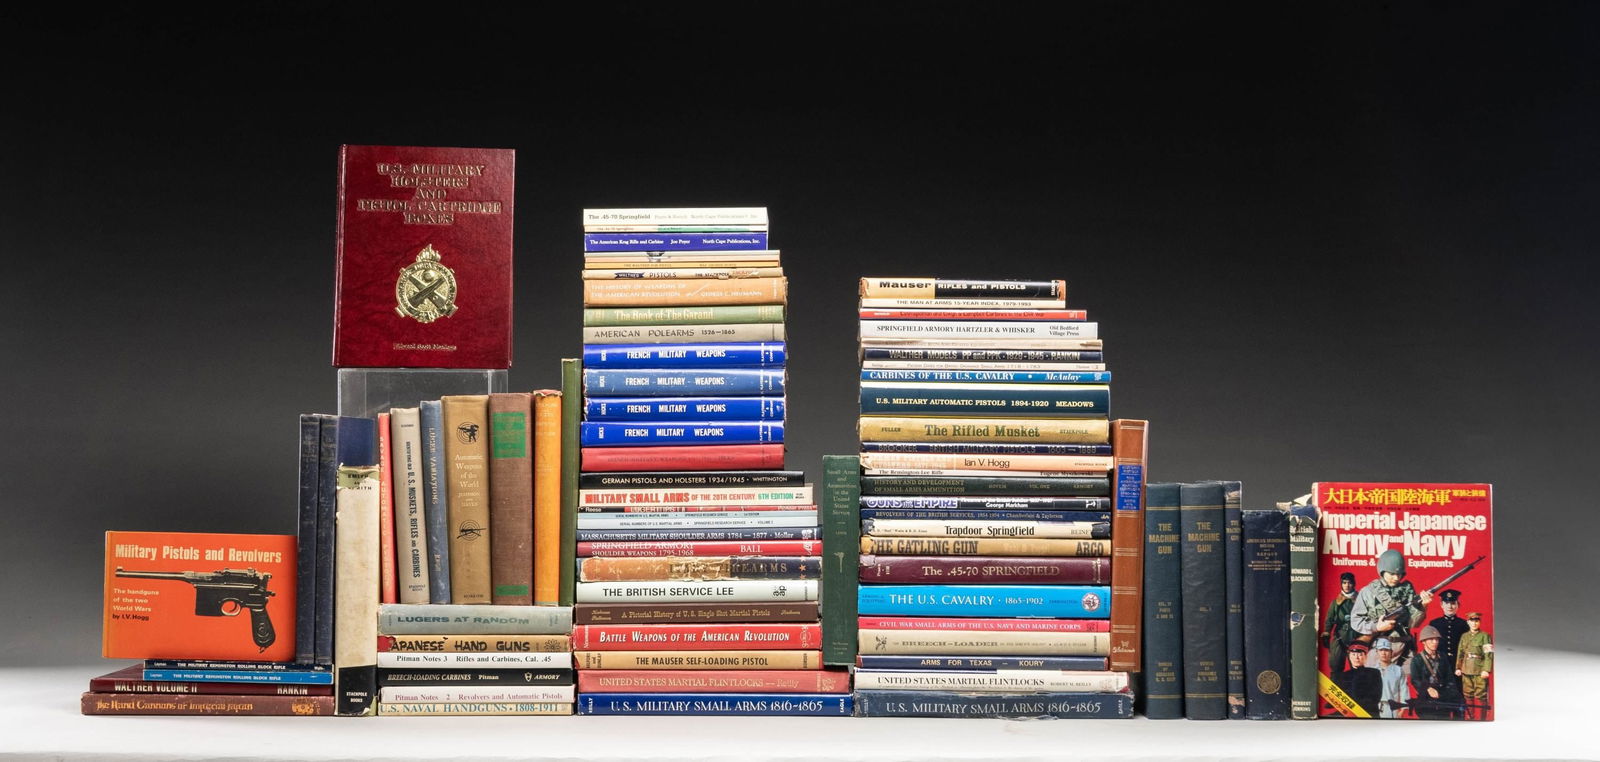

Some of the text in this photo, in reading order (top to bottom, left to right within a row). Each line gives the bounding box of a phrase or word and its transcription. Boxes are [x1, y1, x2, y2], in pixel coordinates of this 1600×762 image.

[411, 164, 484, 176] MILITARY
[415, 187, 447, 199] AND
[418, 201, 501, 214] CARTRIDGE
[404, 213, 454, 225] BOXES
[879, 281, 931, 289] Mauser
[627, 350, 726, 359] FRENCH MILITARY WEAPONS
[870, 371, 916, 379] CARBINES
[918, 371, 931, 379] OF
[975, 372, 1015, 380] CAVALRY
[625, 377, 725, 386] FRENCH MILITARY WEAPONS
[627, 404, 726, 413] FRENCH MILITARY WEAPONS
[624, 428, 724, 437] FRENCH MILITARY WEAPONS
[924, 424, 1040, 437] The Rifled Musket
[430, 456, 438, 505] VARIATIONS
[1324, 487, 1451, 505] 大日本帝国陸海軍
[1197, 522, 1211, 530] THE
[1322, 511, 1487, 532] Imperial Japanese
[944, 526, 1035, 536] Trapdoor Springfield
[1158, 523, 1172, 531] THE
[1149, 534, 1180, 543] MACHINE
[1188, 533, 1220, 542] MACHINE
[1197, 544, 1212, 553] GUN
[1322, 529, 1390, 559] Army
[1388, 535, 1404, 543] and
[1403, 530, 1467, 560] Navy
[115, 544, 282, 563] Military Pistols and Revolvers
[1158, 545, 1173, 554] GUN
[1333, 558, 1376, 566] Uniforms &
[1408, 558, 1454, 569] Equipments
[922, 566, 1060, 576] The .45-70 SPRINGFIELD
[127, 588, 159, 596] handguns
[603, 587, 734, 596] THE BRITISH SERVICE LEE
[889, 594, 914, 604] THE
[918, 595, 938, 604] U.S.
[941, 595, 994, 605] CAVALRY
[636, 657, 769, 665] THE MAUSER SELF-LOADING PISTOL
[913, 677, 947, 685] STATES
[948, 677, 987, 685] MARTIAL
[989, 678, 1045, 686] FLINTLOCKS
[114, 683, 308, 695] WALTHER VOLUME II RANKIN
